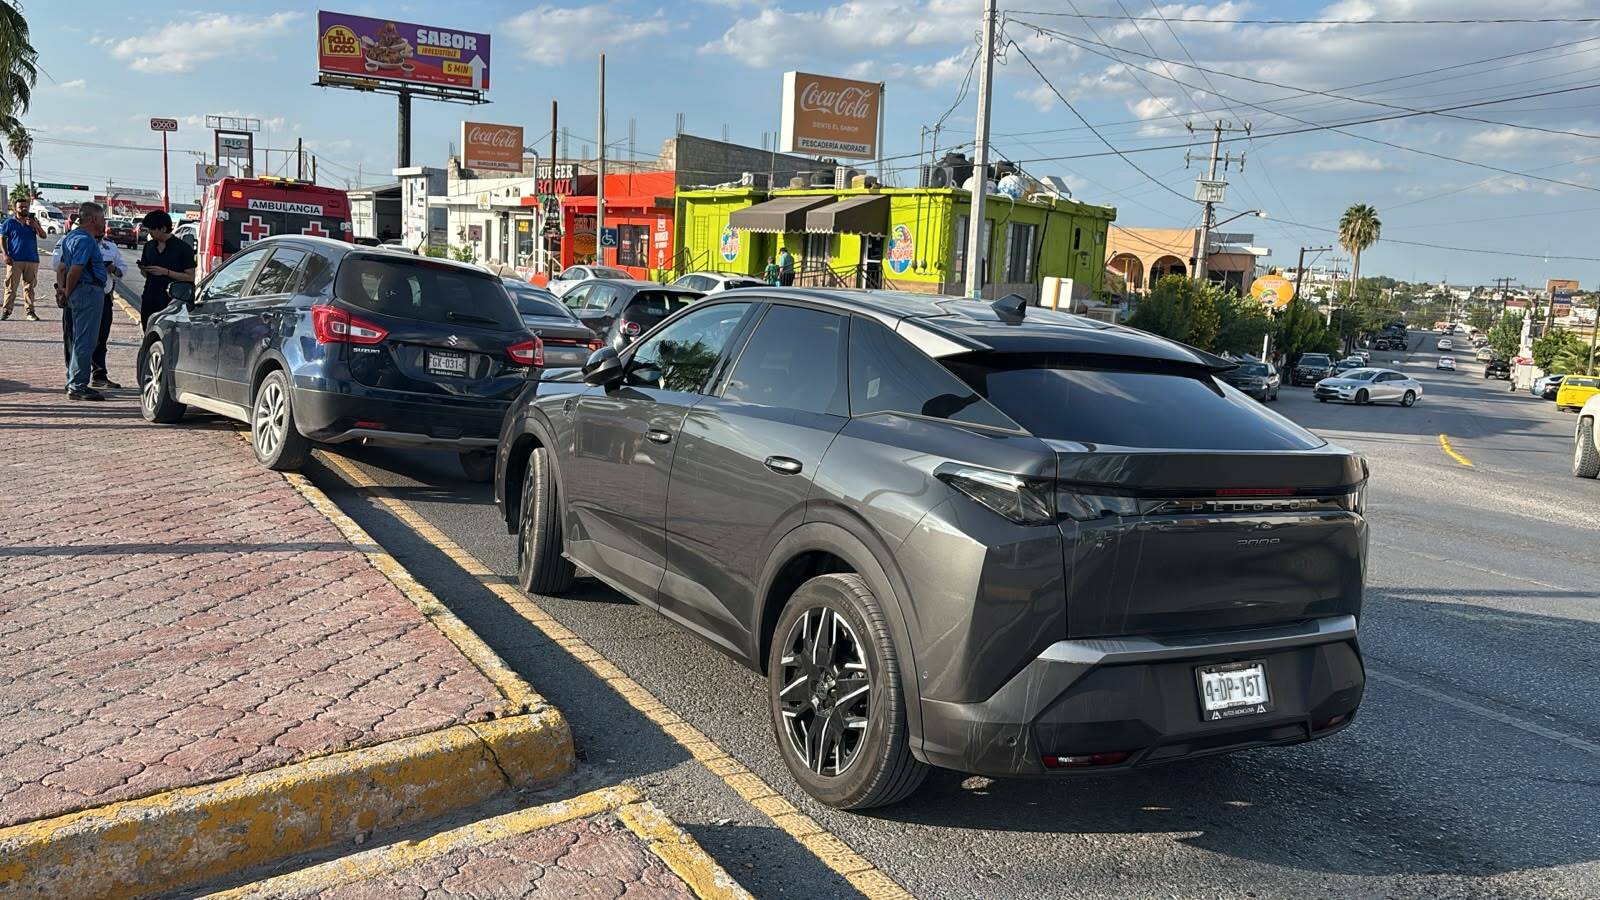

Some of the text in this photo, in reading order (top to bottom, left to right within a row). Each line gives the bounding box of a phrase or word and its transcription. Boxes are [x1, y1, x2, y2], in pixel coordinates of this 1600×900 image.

[417, 29, 477, 50] SABOR
[329, 45, 355, 53] LOCO
[453, 64, 469, 74] MIN
[151, 120, 176, 129] OXXO
[839, 143, 866, 152] ANDRADE
[251, 200, 320, 214] AMBULANCIA
